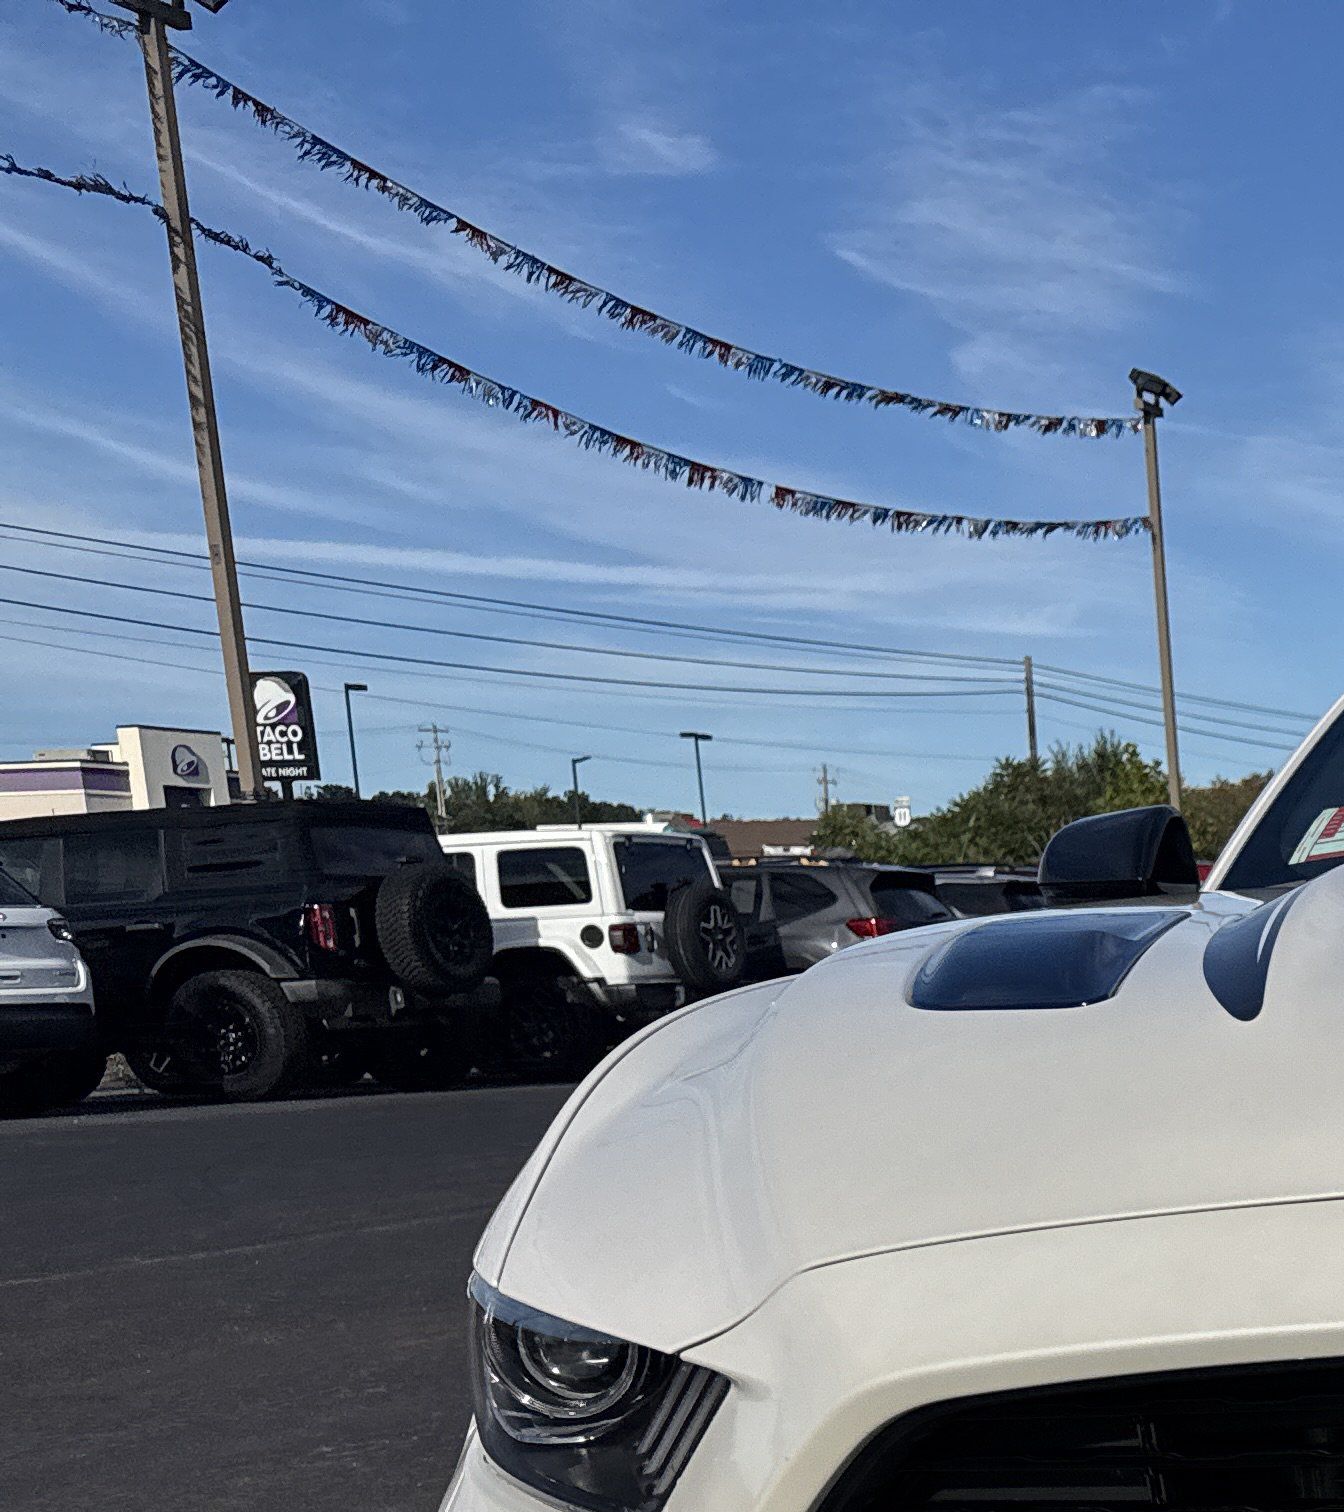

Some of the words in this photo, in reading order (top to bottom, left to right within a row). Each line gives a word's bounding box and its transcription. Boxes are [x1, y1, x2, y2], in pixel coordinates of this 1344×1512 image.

[256, 725, 303, 743] TACO
[259, 743, 305, 760] BELL
[262, 766, 277, 777] ATE
[279, 766, 307, 777] NIGHT
